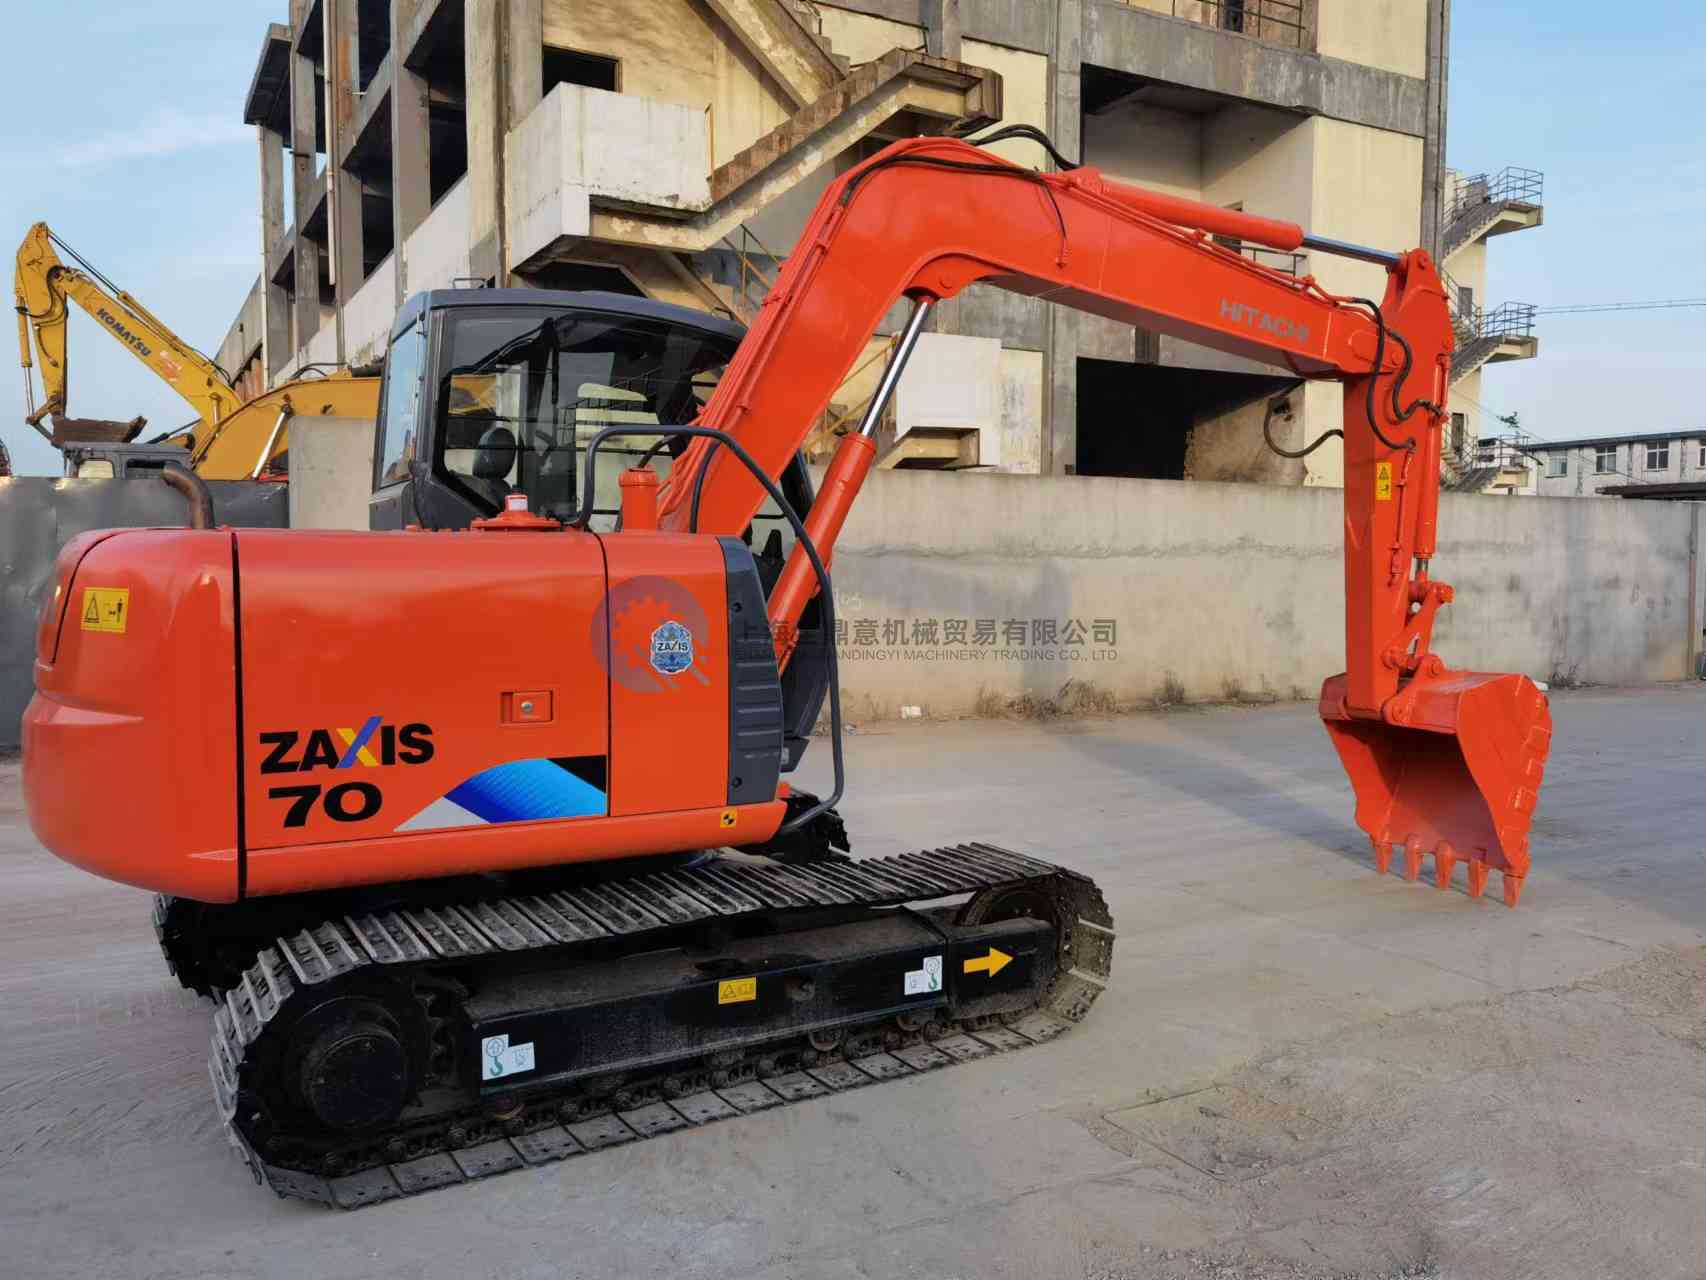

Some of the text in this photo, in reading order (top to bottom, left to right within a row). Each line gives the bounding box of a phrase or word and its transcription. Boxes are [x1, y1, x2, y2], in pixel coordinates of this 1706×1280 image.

[97, 308, 151, 356] KOMATSU
[259, 716, 435, 775] ZAXIS
[268, 781, 383, 828] 70
